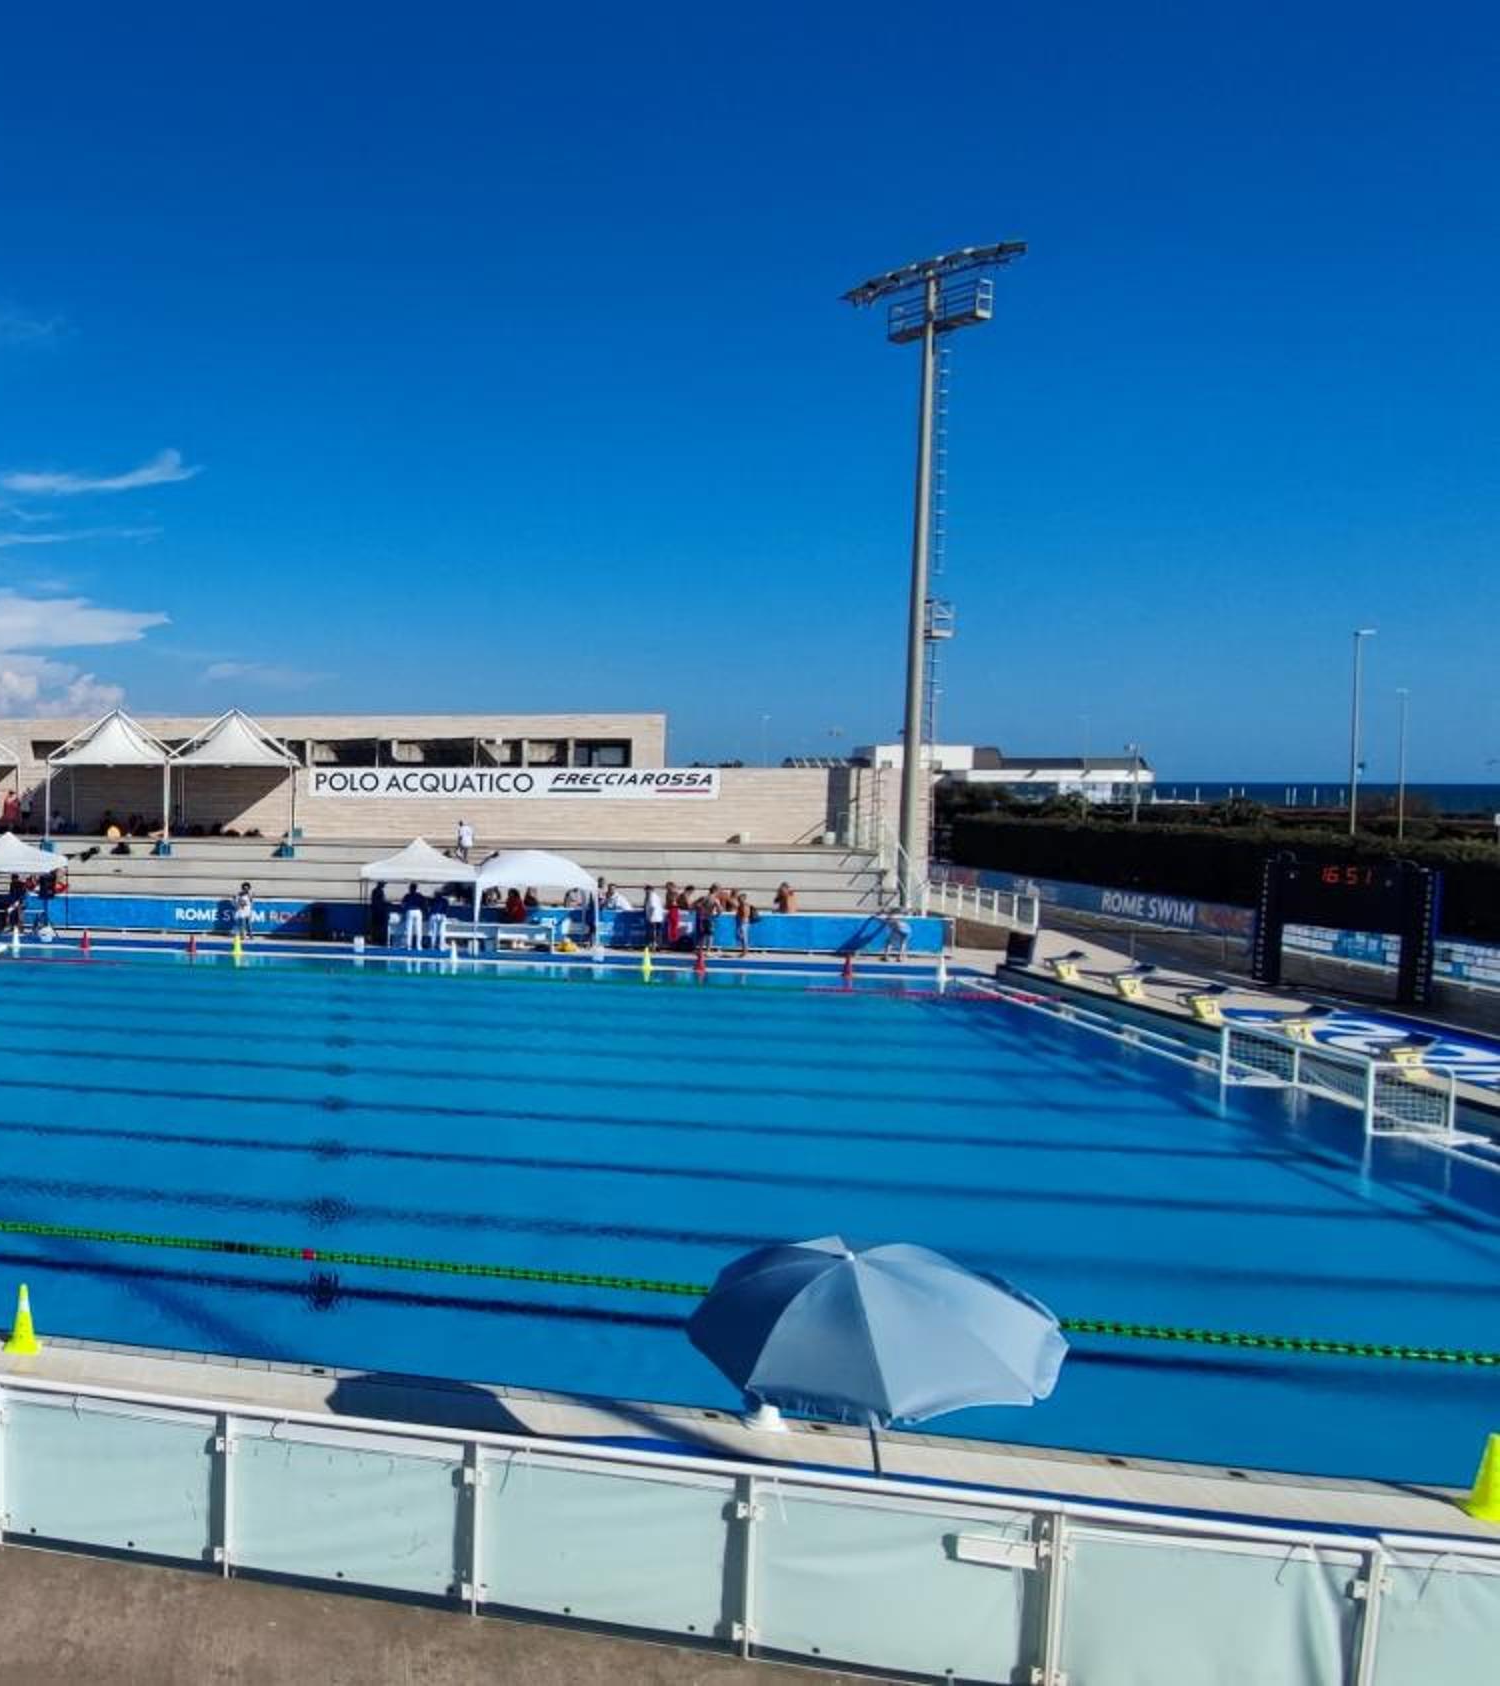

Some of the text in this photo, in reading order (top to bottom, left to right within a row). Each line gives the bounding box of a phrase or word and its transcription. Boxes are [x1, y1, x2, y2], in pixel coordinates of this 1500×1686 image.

[315, 772, 713, 793] POLO ACQUATICO FRECCIAROSSA
[175, 908, 219, 921] ROME
[1101, 892, 1144, 917] ROME
[1148, 898, 1195, 924] SWIM
